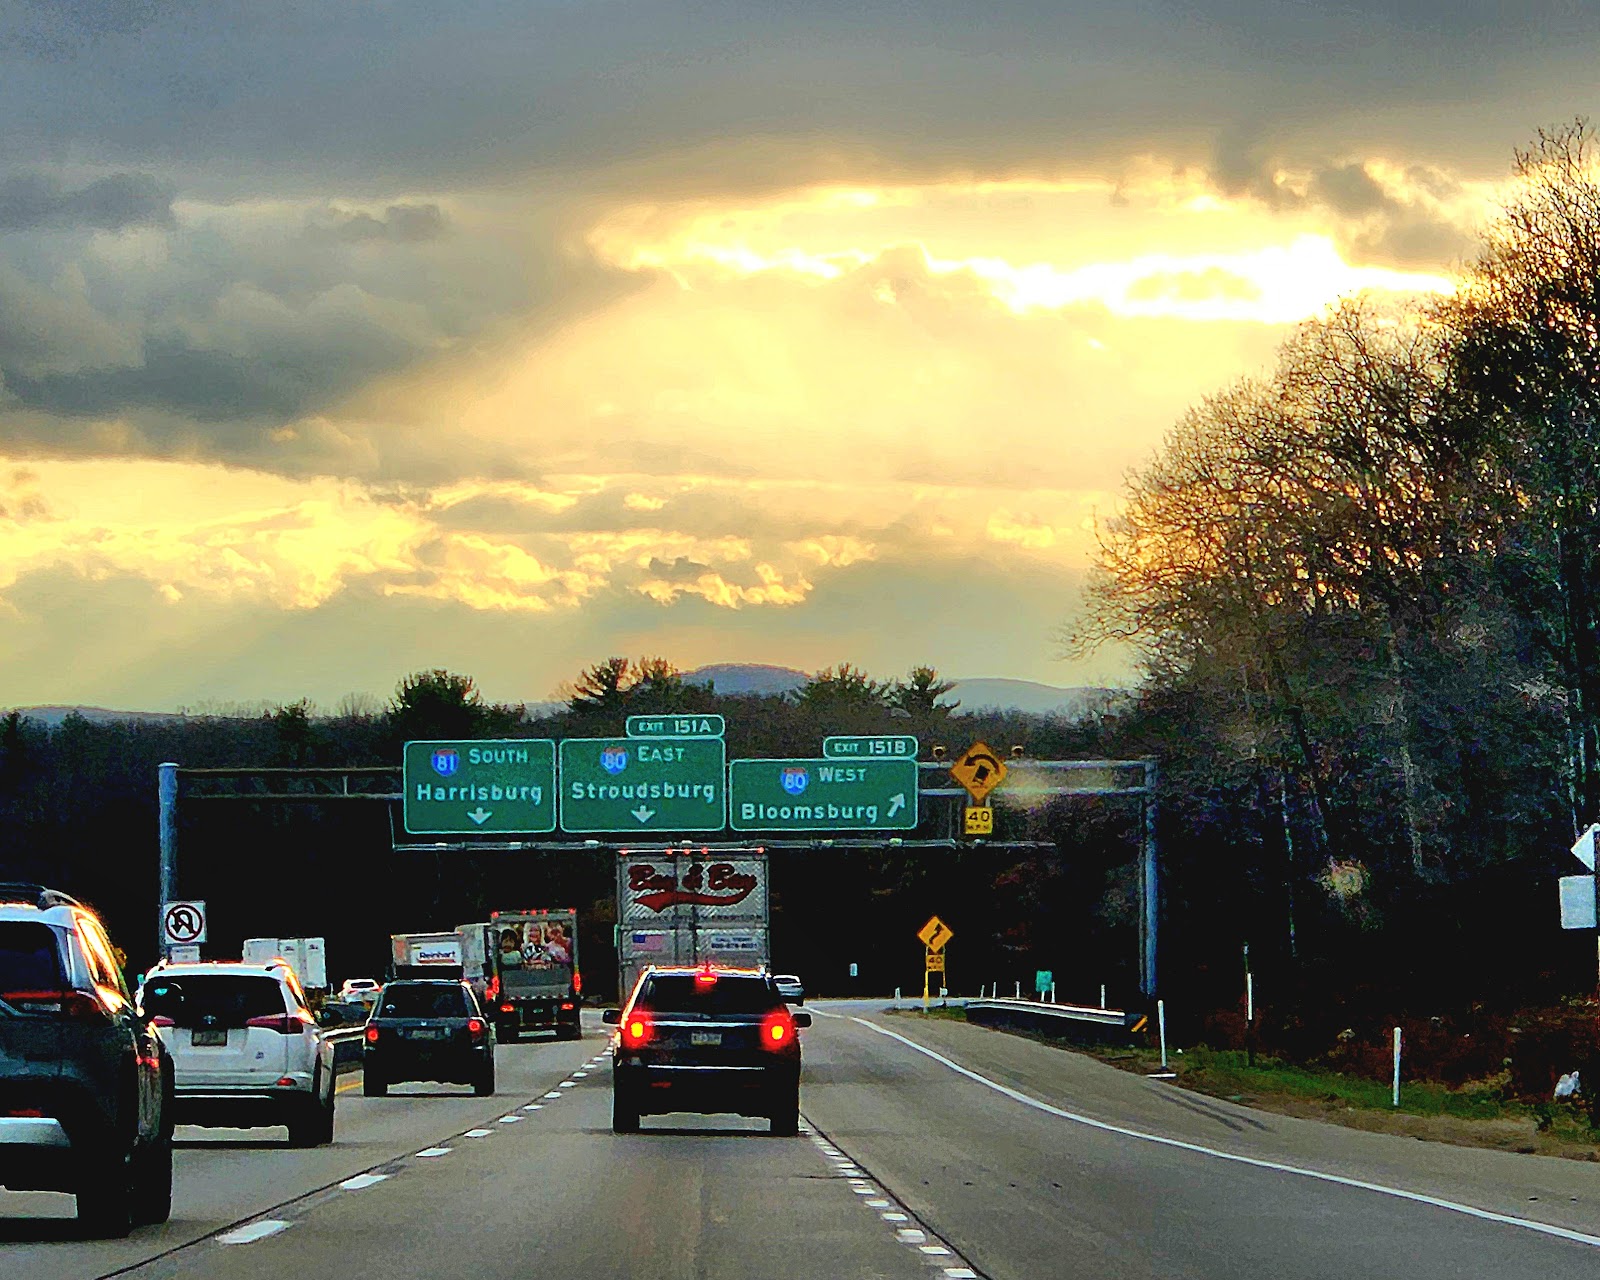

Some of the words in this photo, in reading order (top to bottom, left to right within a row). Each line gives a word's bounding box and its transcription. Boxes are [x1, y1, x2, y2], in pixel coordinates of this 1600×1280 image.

[639, 722, 663, 731] EXIT
[674, 720, 711, 733] 151A
[605, 752, 627, 770] 80
[637, 745, 685, 762] EAST
[834, 743, 858, 752] EXIT
[869, 741, 906, 754] 151B
[436, 754, 455, 771] 81
[468, 748, 528, 764] SOUTH
[784, 774, 806, 790] 80
[819, 767, 866, 782] WEST
[416, 784, 543, 805] Harrisburg
[571, 782, 715, 803] Stroudsburg
[741, 804, 878, 823] Bloomsburg
[968, 811, 990, 822] 40
[929, 956, 942, 964] 40
